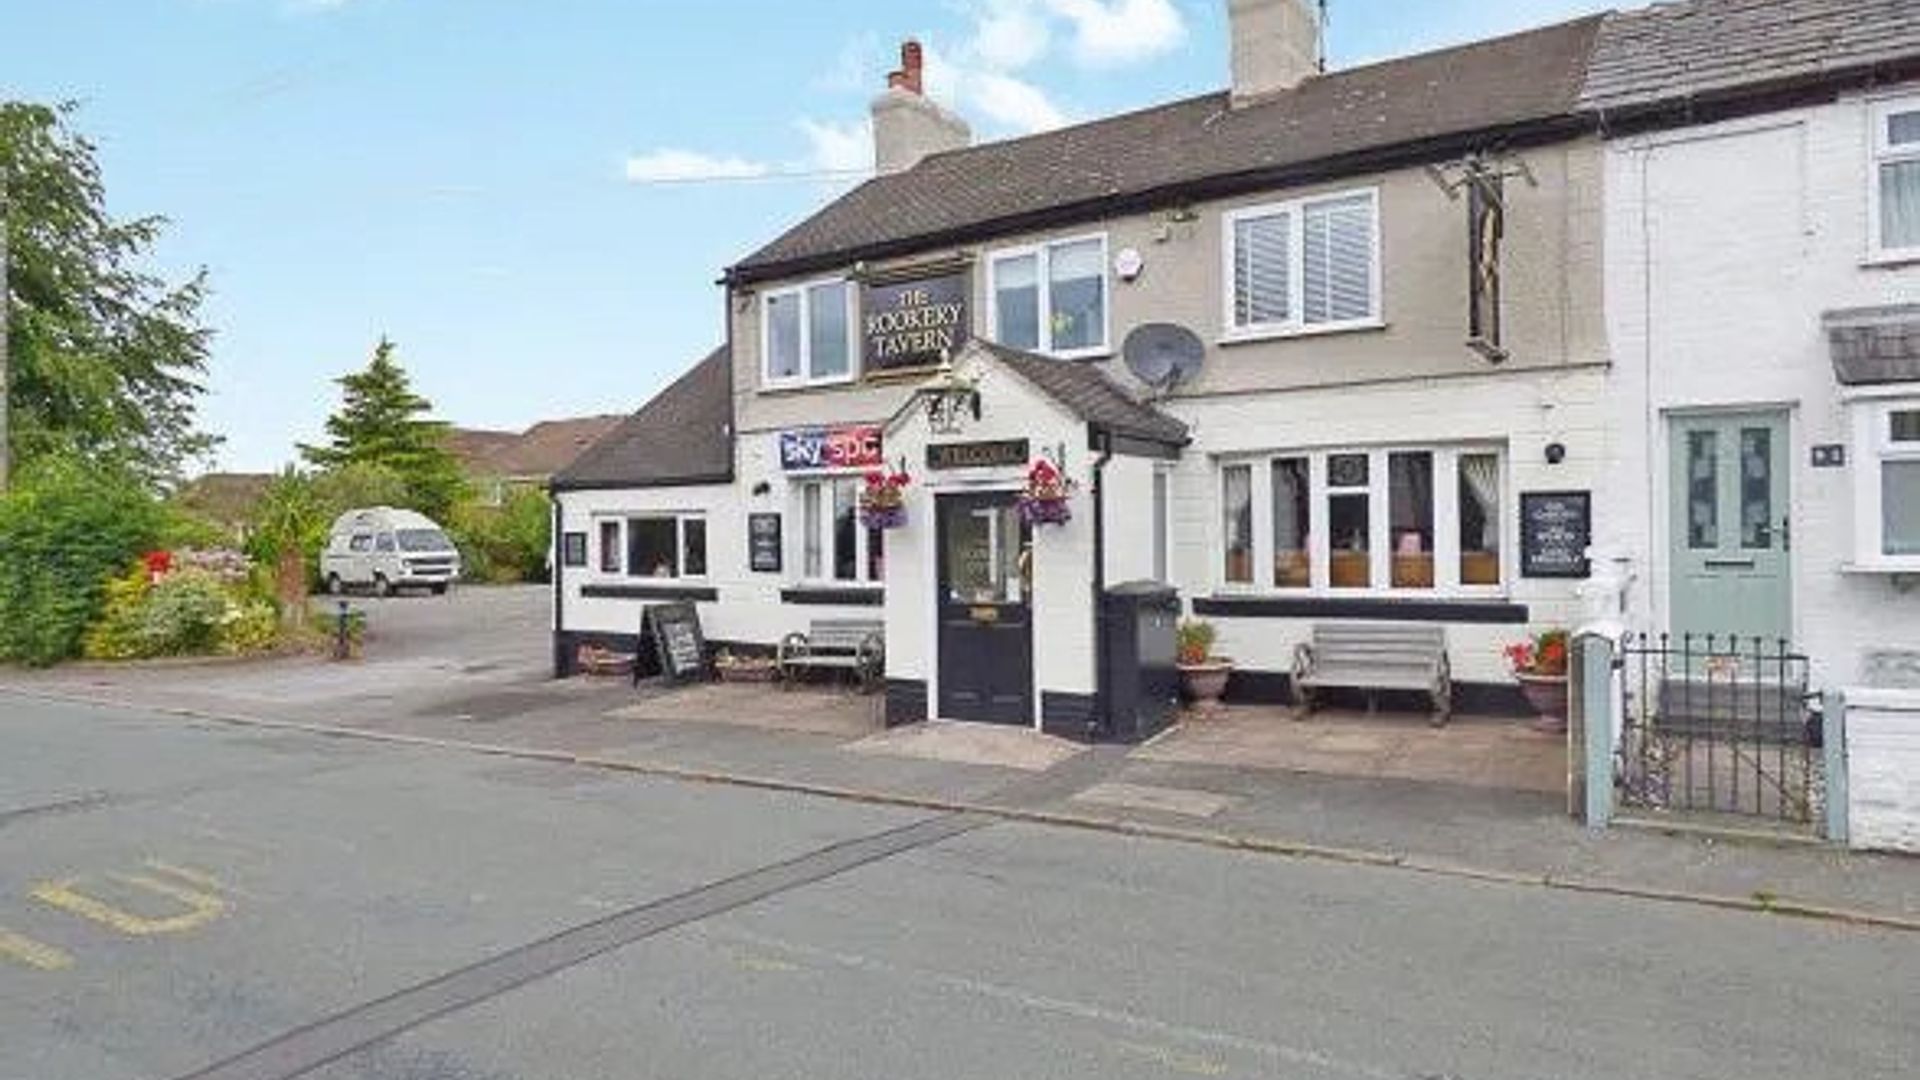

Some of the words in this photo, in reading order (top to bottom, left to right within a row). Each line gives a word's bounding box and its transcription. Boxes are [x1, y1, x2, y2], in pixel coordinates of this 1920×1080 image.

[898, 289, 930, 307] THE
[866, 302, 964, 334] ROOKERY
[872, 327, 953, 358] TAVERN
